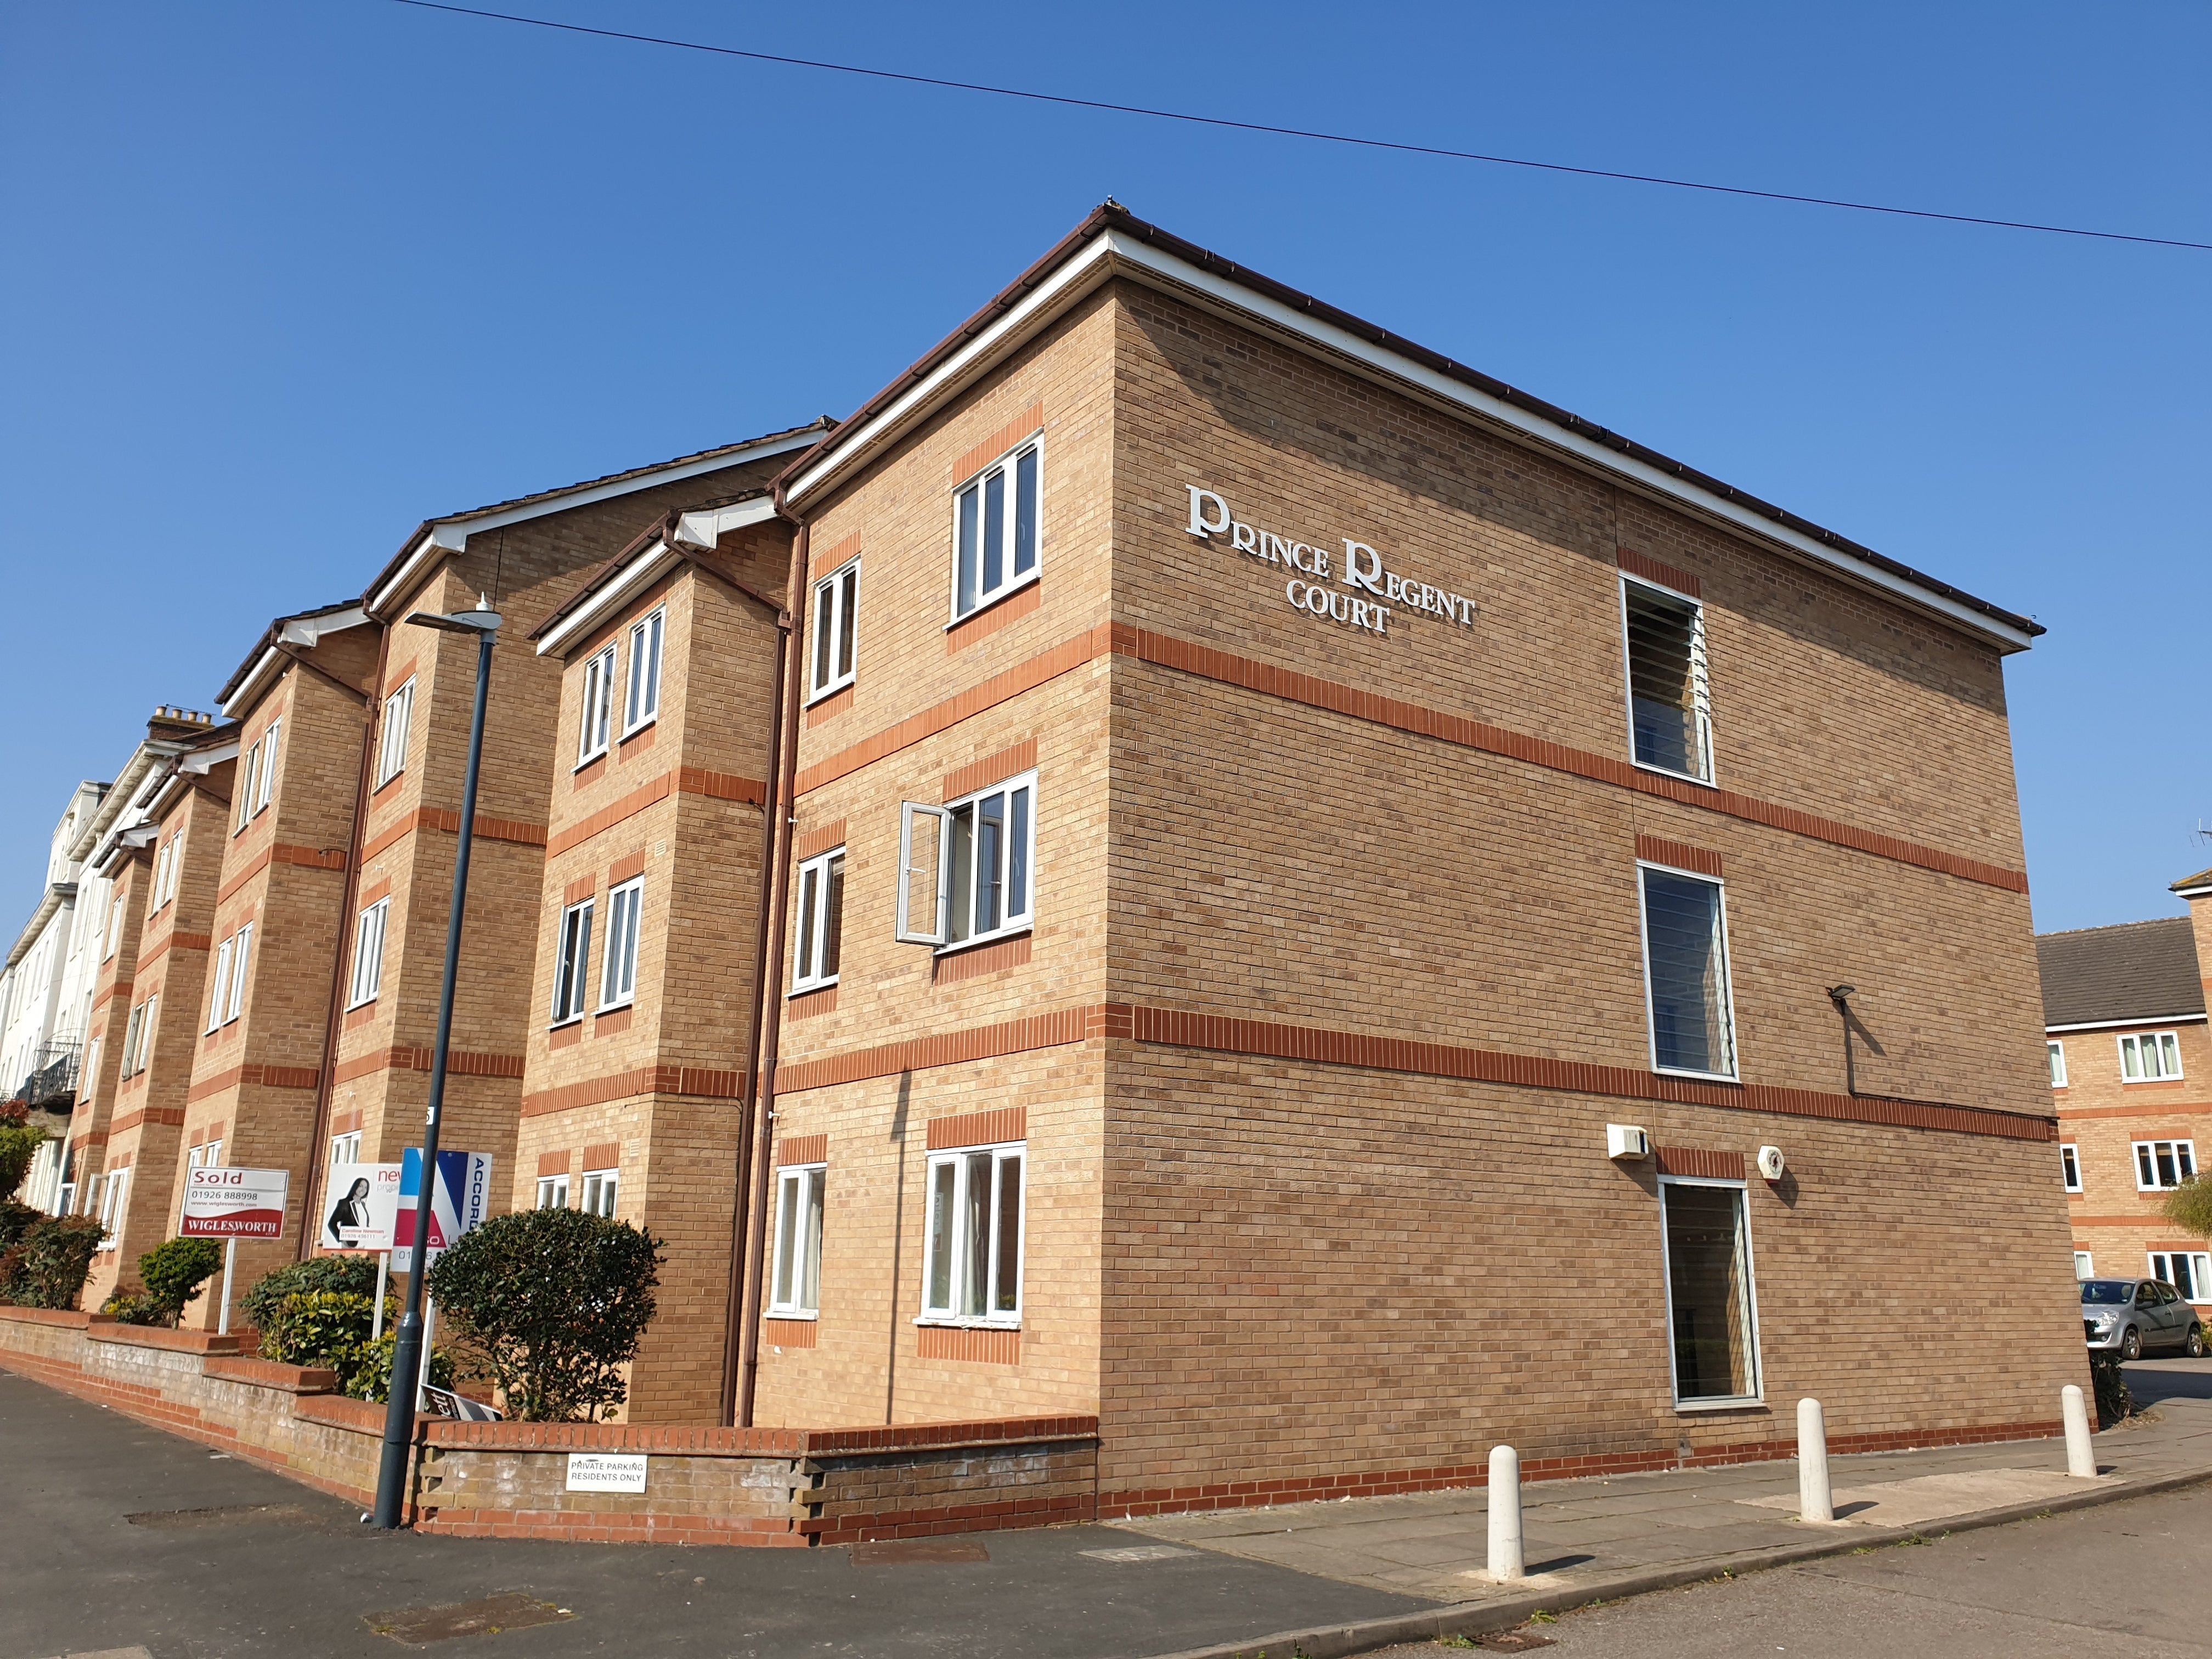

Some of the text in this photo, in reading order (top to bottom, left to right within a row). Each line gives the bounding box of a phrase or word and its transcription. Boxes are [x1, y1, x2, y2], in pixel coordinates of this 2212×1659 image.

[1286, 580, 1390, 633] COURT
[194, 1171, 242, 1184] Sold
[192, 1190, 257, 1200] 01926 888998
[188, 1220, 277, 1233] WIGLESWORTH
[572, 1462, 604, 1470] PRIVATE
[572, 1472, 641, 1482] RESIDENTS ONLY
